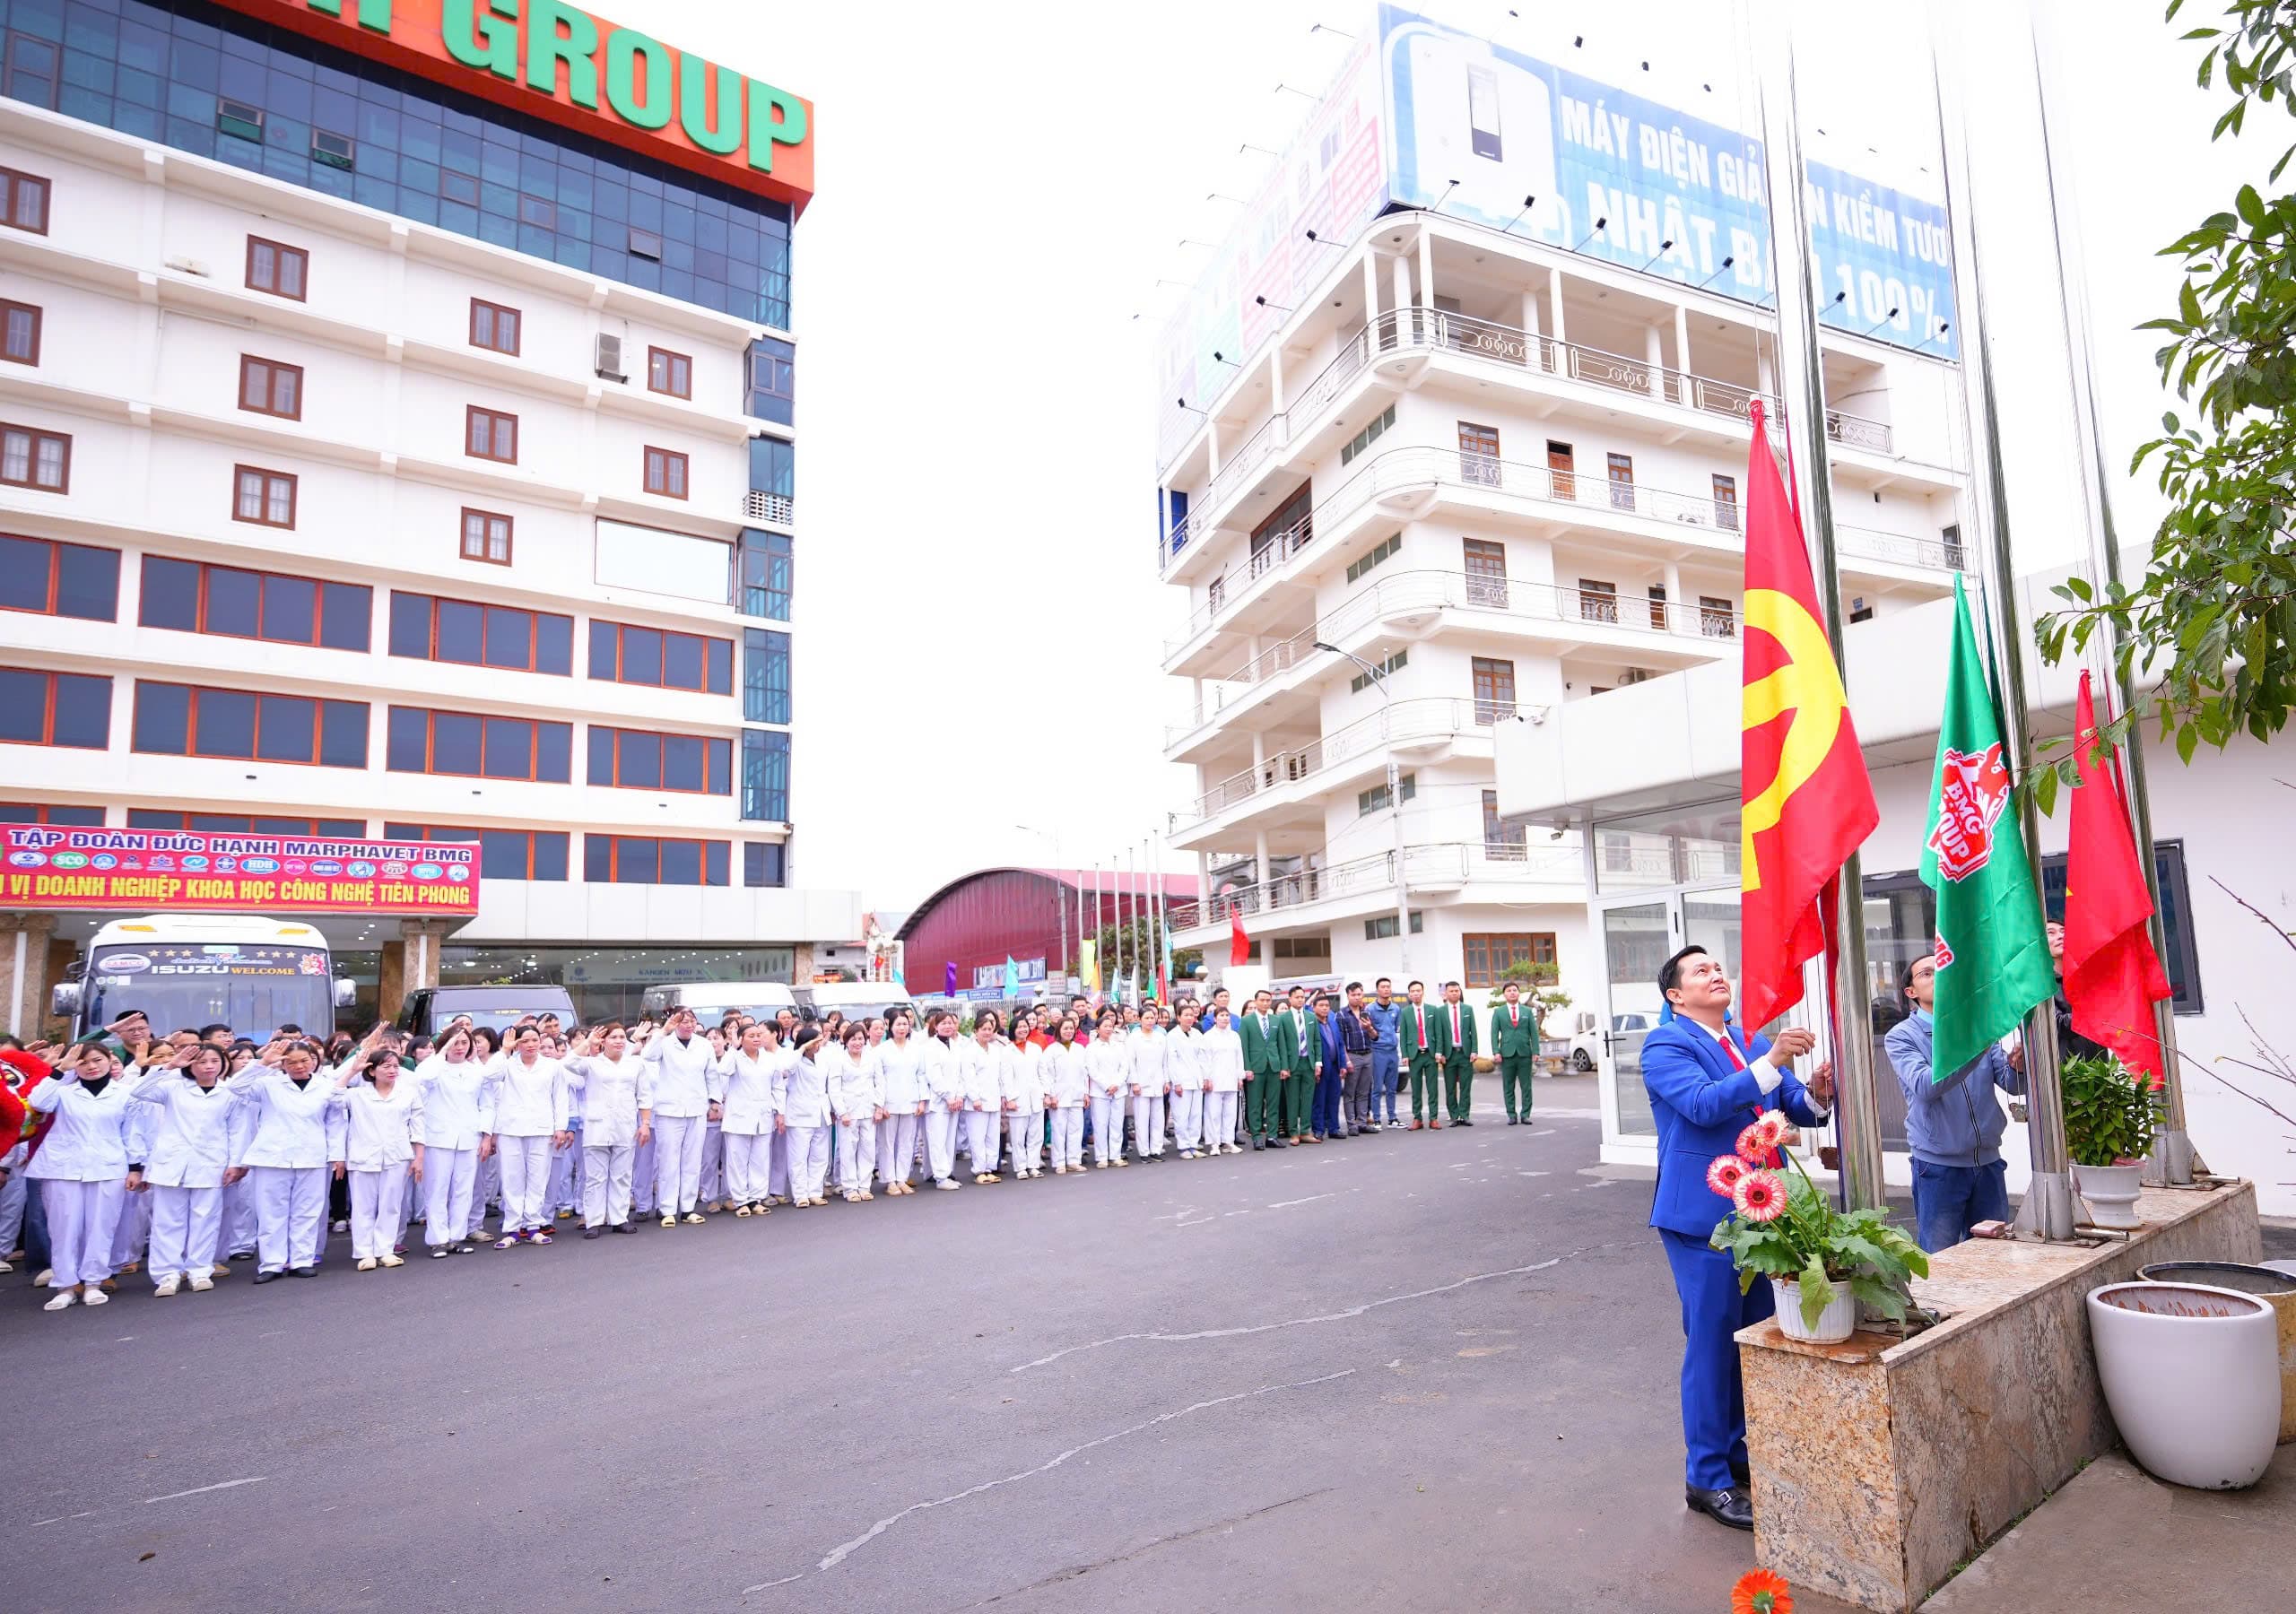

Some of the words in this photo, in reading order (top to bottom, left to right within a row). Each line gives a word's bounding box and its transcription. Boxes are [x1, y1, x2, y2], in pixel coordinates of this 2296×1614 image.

[441, 0, 806, 173] GROUP
[1561, 96, 1630, 161] MÁY
[1639, 124, 1711, 190] ĐIỆN
[1717, 143, 1768, 208] GIẢ
[1833, 189, 1899, 252] KIỀM
[1900, 215, 1948, 268] TƯƠ
[1587, 181, 1717, 280] NHẬT
[1836, 264, 1950, 344] 100%
[1944, 779, 1984, 834] BMG
[11, 829, 64, 848] TẬP
[71, 832, 145, 849] ĐOÀN
[153, 834, 204, 851] ĐỨC
[212, 838, 278, 855] HẠNH
[285, 842, 419, 860] MARPHAVET
[424, 849, 471, 862] BMG
[1939, 811, 1970, 858] OUP
[11, 874, 30, 899] VỊ
[36, 875, 106, 897] DOANH
[110, 875, 180, 901] NGHIỆP
[187, 879, 235, 898] KHOA
[240, 880, 275, 903] HỌC
[281, 878, 326, 901] CÔNG
[331, 881, 375, 905] NGHỆ
[379, 881, 414, 904] TIÊN
[418, 885, 470, 905] PHONG
[105, 959, 145, 968] SAMCO
[151, 965, 230, 975] ISUZU
[230, 967, 296, 976] WELCOME
